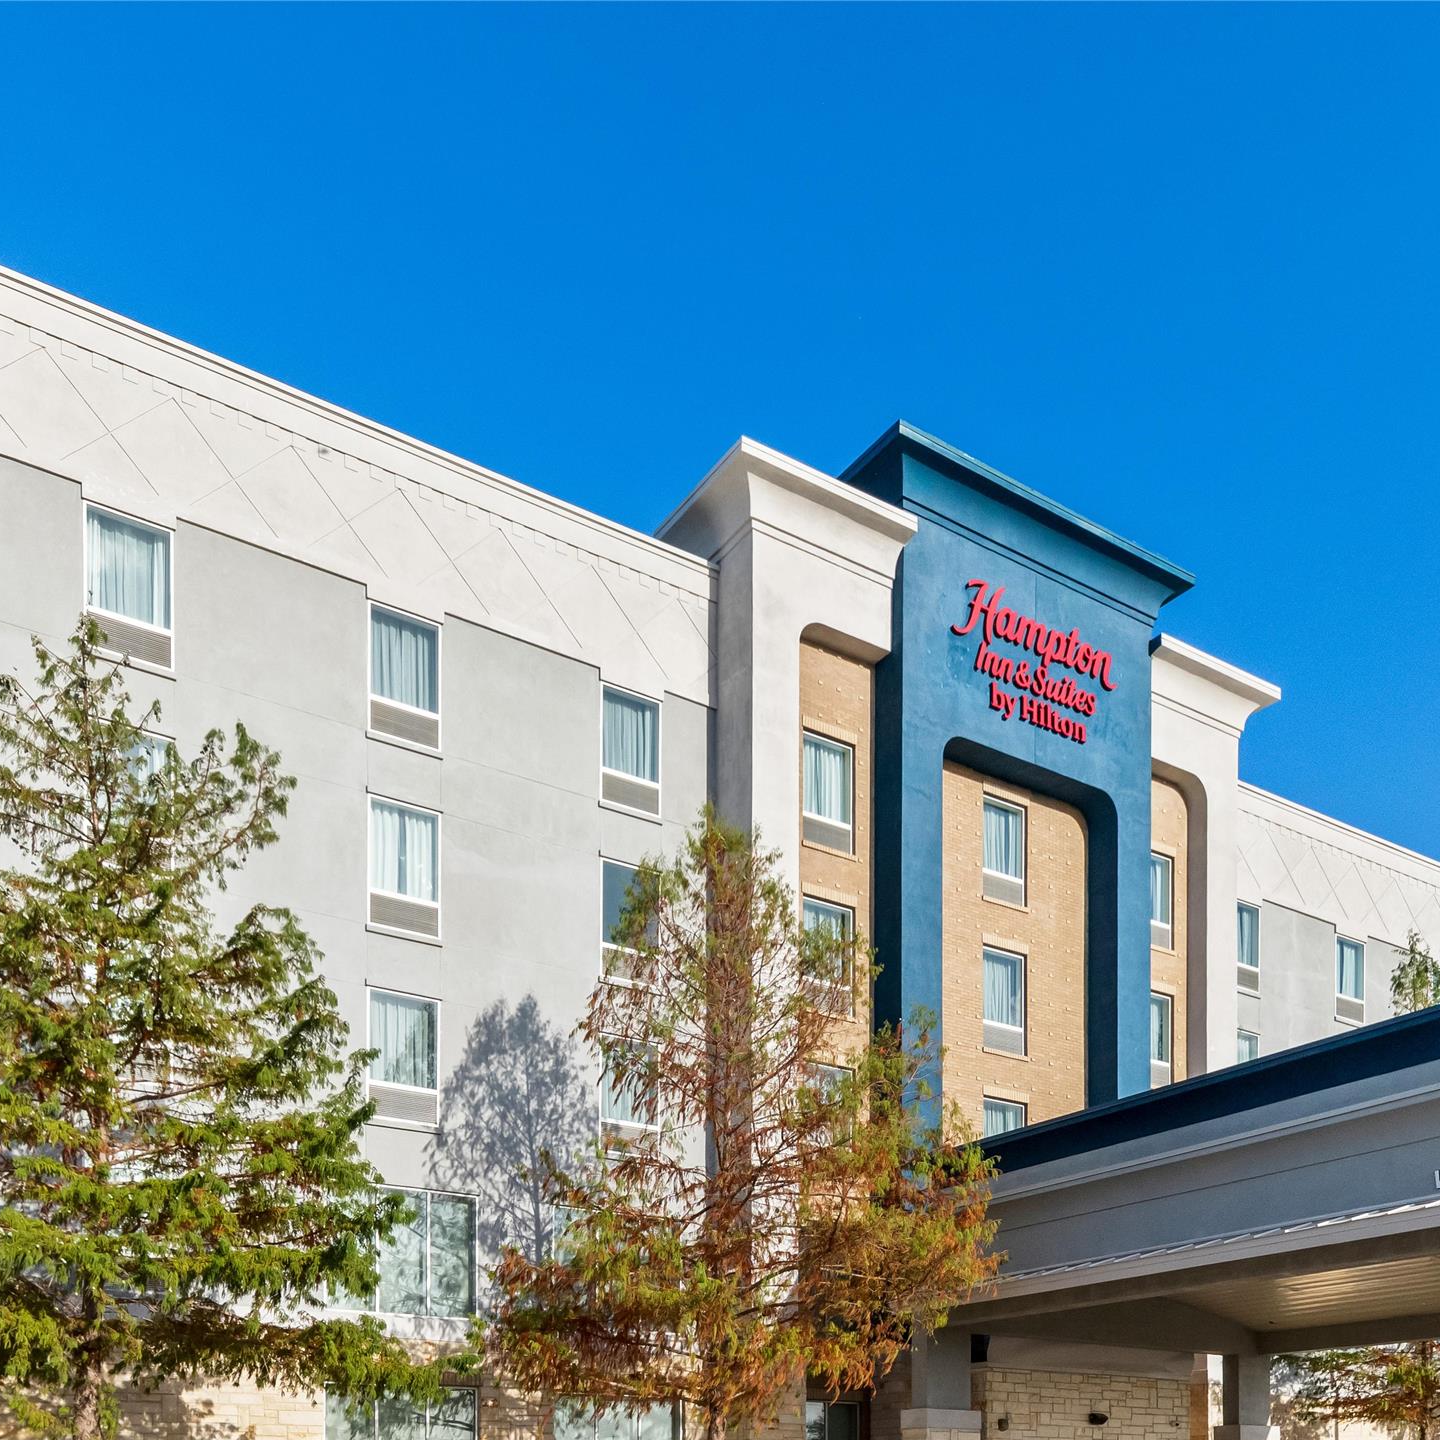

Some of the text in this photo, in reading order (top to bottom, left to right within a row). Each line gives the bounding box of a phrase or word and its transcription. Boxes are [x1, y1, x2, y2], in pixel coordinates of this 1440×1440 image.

[950, 578, 1117, 691] Hampton
[974, 641, 1097, 717] Inn & Suites
[989, 682, 1087, 744] by Hilton
